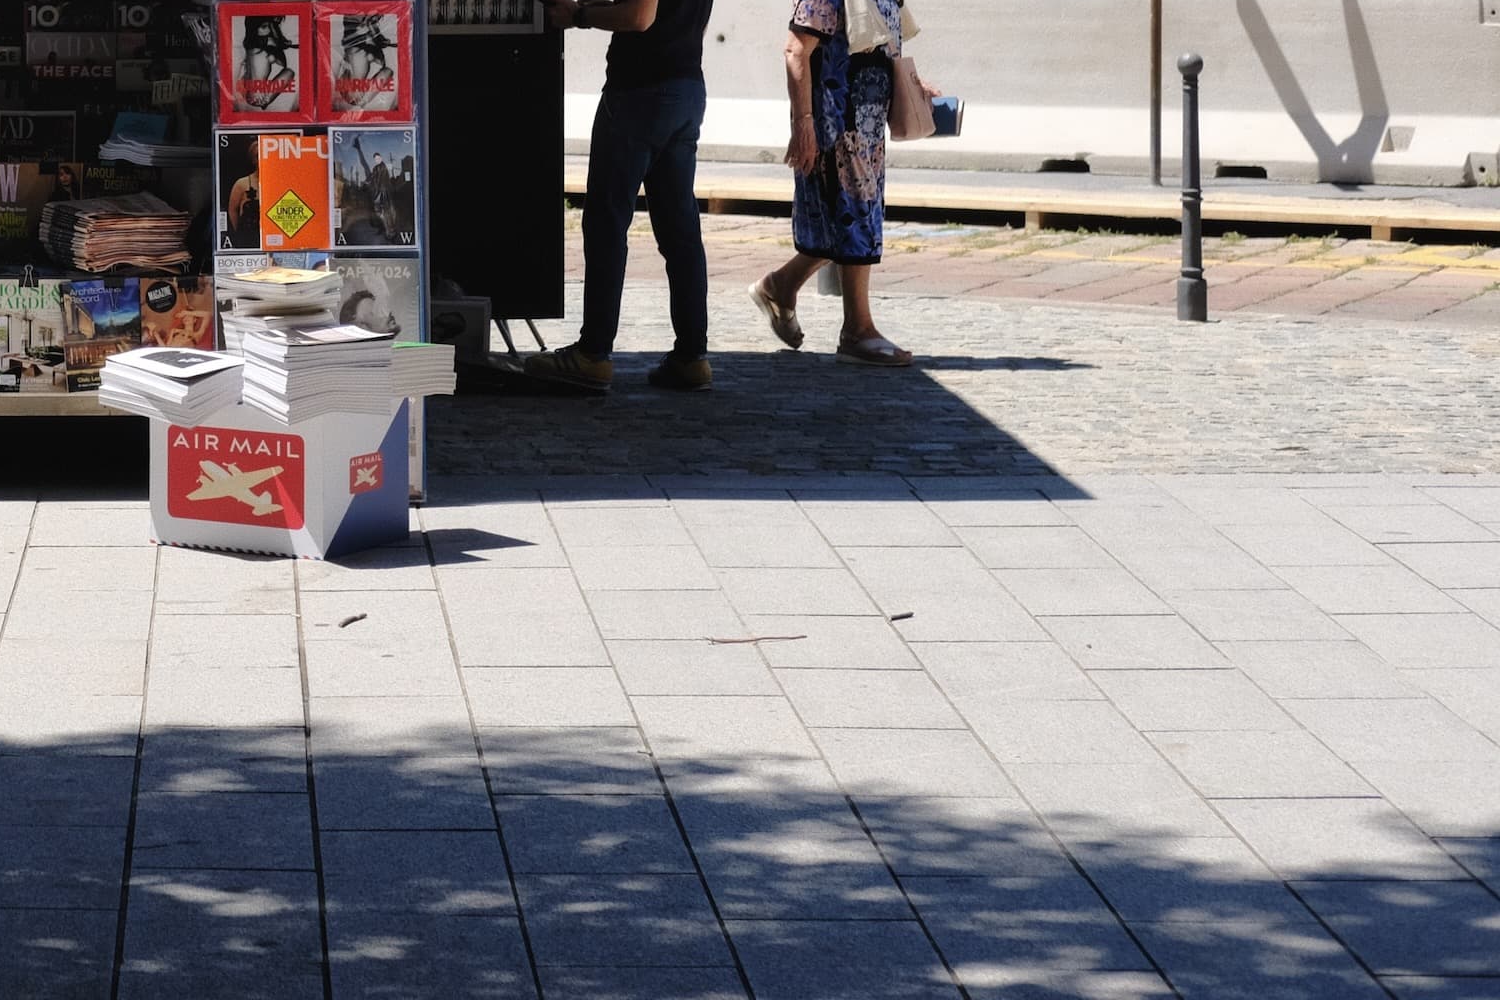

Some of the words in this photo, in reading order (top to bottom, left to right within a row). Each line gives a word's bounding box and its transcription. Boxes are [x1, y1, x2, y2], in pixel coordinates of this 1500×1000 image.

[28, 5, 61, 27] 10
[118, 5, 151, 27] 10
[69, 65, 115, 78] FACE
[173, 432, 219, 450] AIR
[229, 437, 300, 458] MAIL
[350, 457, 364, 467] AIR
[364, 453, 384, 465] MAIL
